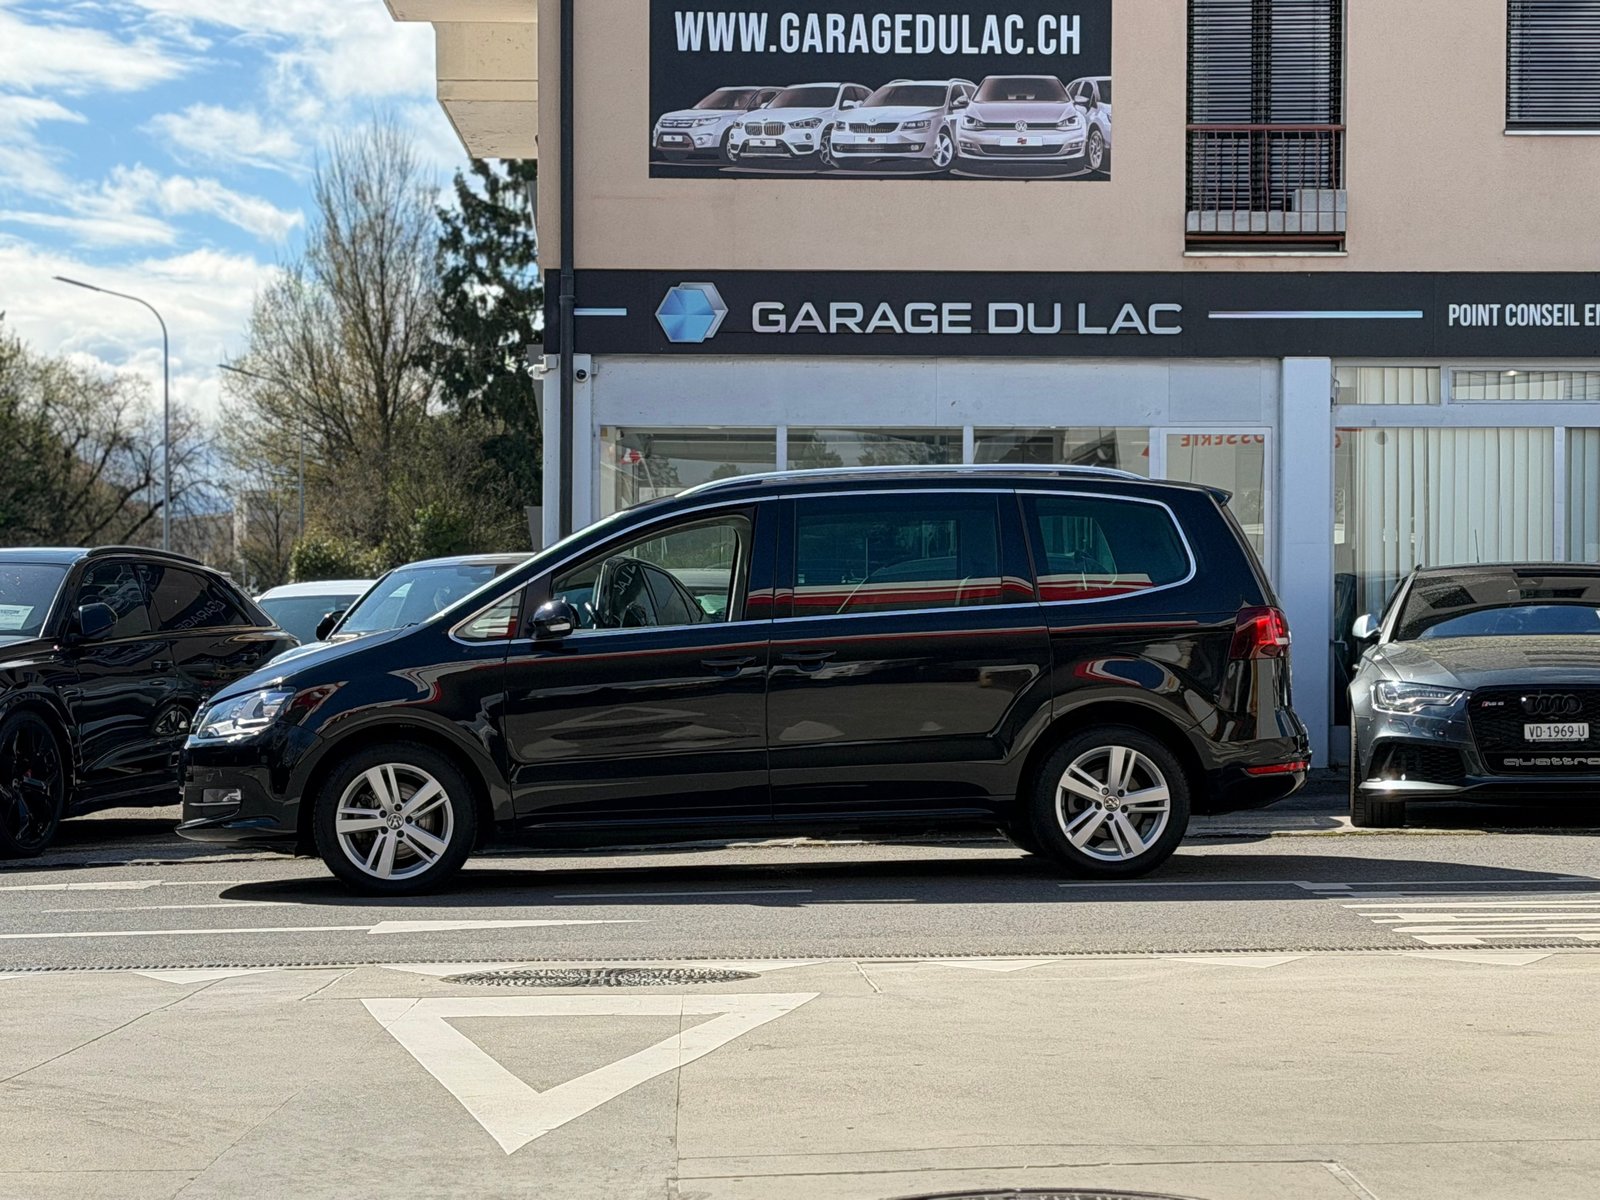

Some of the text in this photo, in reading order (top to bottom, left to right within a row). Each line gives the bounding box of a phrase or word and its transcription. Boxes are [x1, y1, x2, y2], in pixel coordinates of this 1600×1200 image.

[674, 11, 1081, 55] WWW.GARAGEDULAC.CH
[751, 300, 1182, 337] GARAGE DU LAC
[1448, 303, 1502, 327] POINT
[1504, 303, 1581, 327] CONSEIL
[1503, 757, 1600, 767] quattro
